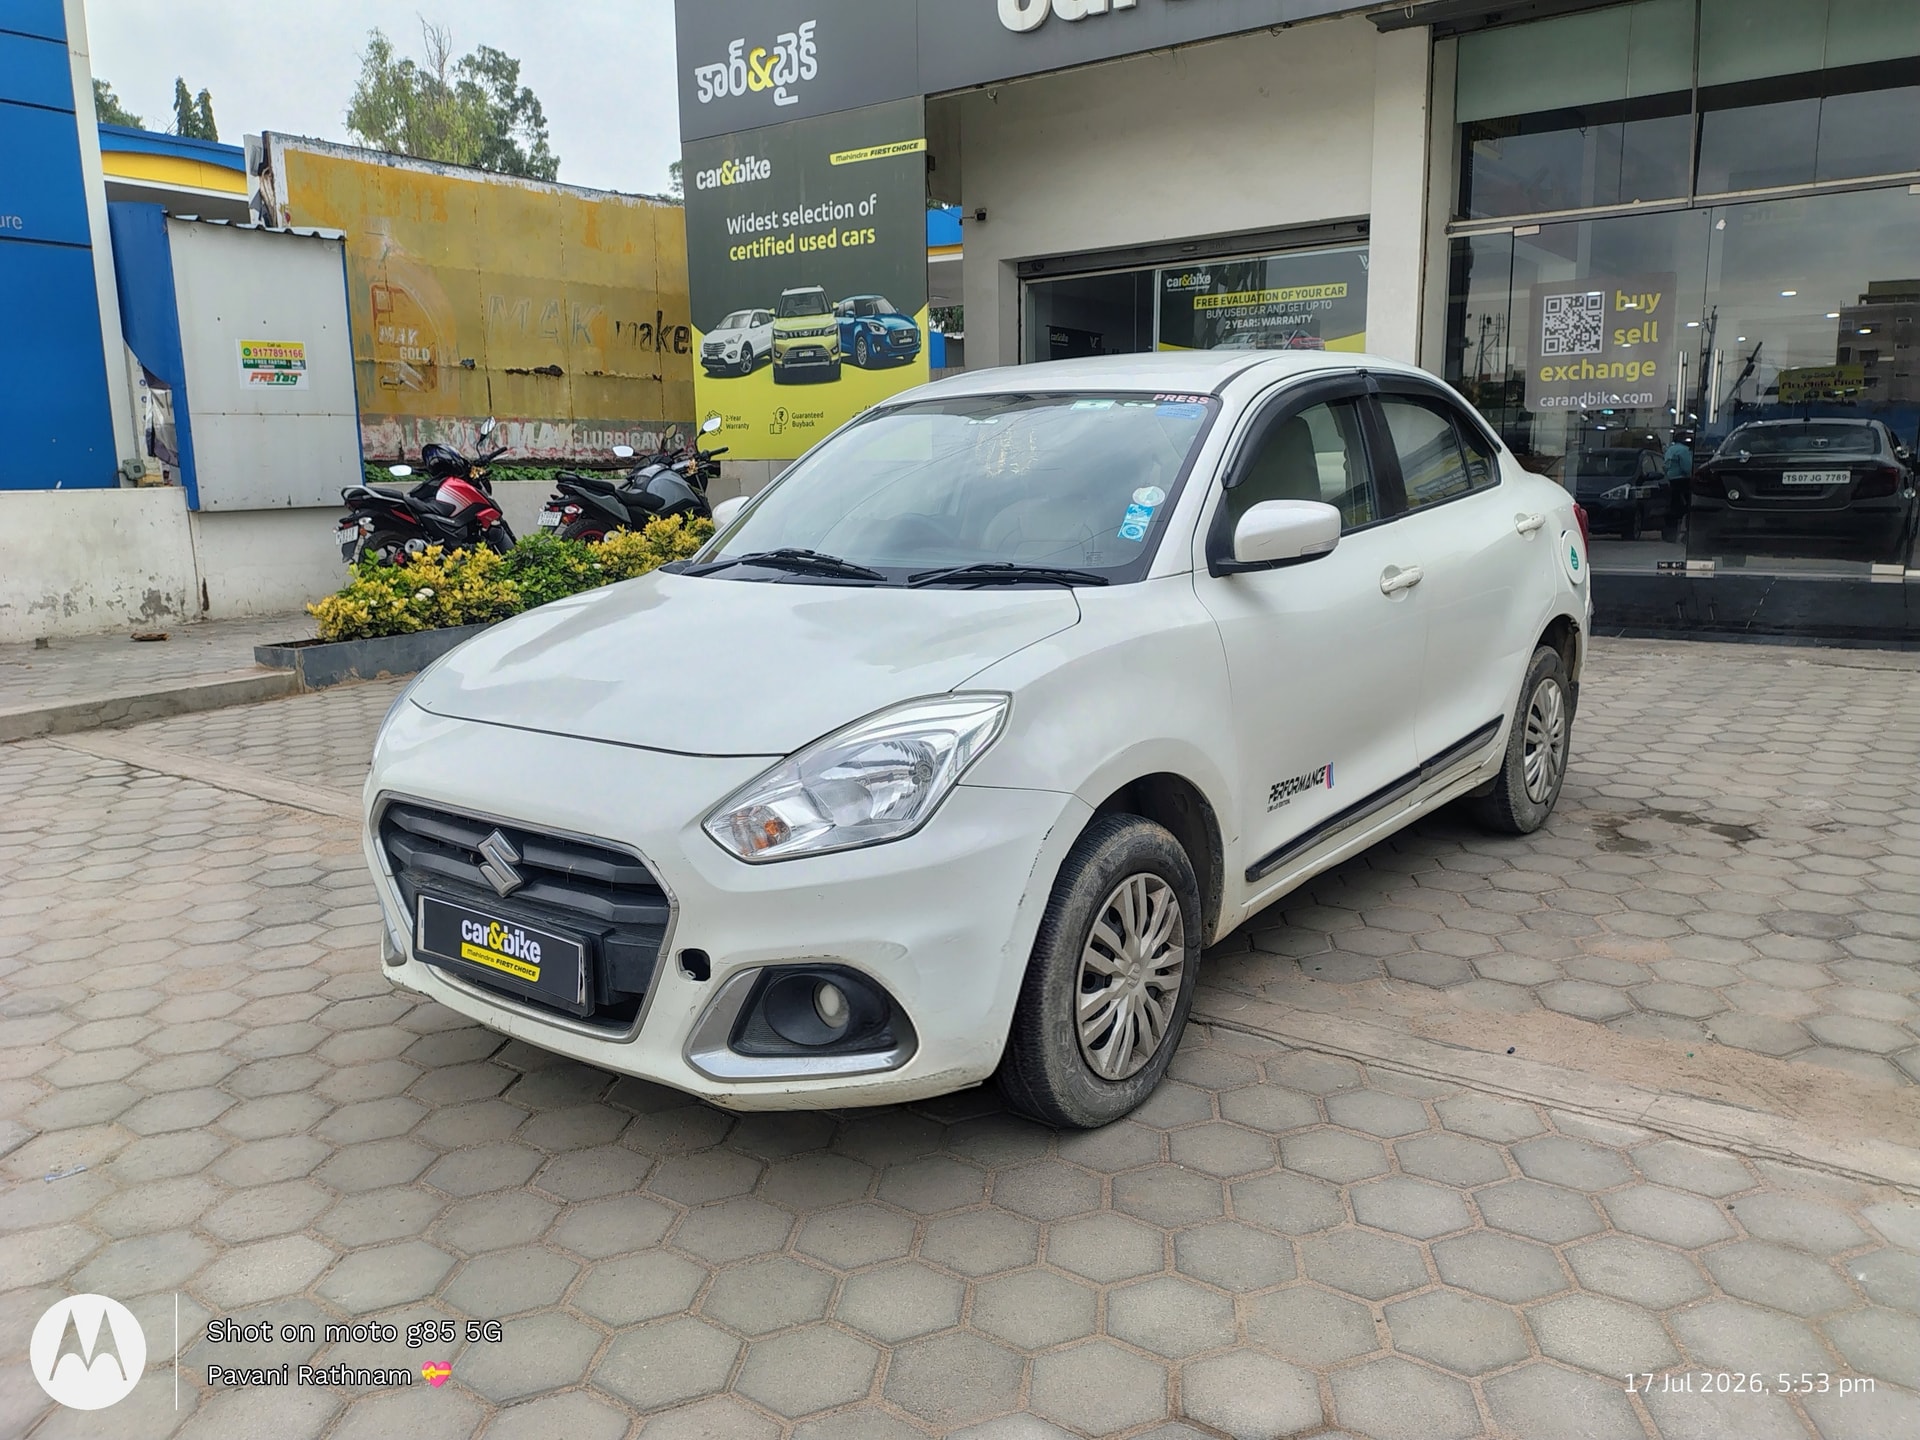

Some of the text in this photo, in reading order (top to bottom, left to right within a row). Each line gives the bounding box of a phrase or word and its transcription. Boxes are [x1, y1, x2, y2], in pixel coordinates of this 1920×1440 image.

[835, 142, 919, 162] Mahindra FIRST CHOICE
[696, 155, 771, 190] car&bike
[727, 193, 877, 235] Widest selection of
[729, 227, 876, 262] certified used cars
[1166, 273, 1211, 288] car&bike
[1196, 285, 1345, 308] FREE EVALUATION OF YOUR CAR
[1616, 290, 1661, 314] buy
[1206, 299, 1333, 319] BUY USED CAR AND GET UP TO
[615, 310, 693, 354] make
[1225, 314, 1313, 330] 2 YEARS WARRANTY
[1614, 320, 1659, 345] sell
[252, 347, 304, 358] 9177891166
[400, 347, 430, 360] GOLD
[1540, 358, 1657, 382] exchange
[1153, 394, 1210, 404] PRESS
[1540, 391, 1653, 407] carandbike.com
[725, 414, 742, 422] 2-Year
[791, 411, 824, 420] Guaranteed
[791, 420, 815, 428] Buyback
[725, 422, 750, 430] Warranty
[1810, 474, 1822, 482] JG
[1268, 765, 1326, 804] PERFORMANCE
[461, 920, 541, 963] car&bike
[466, 948, 537, 976] Mahindra FIRST CHOICE
